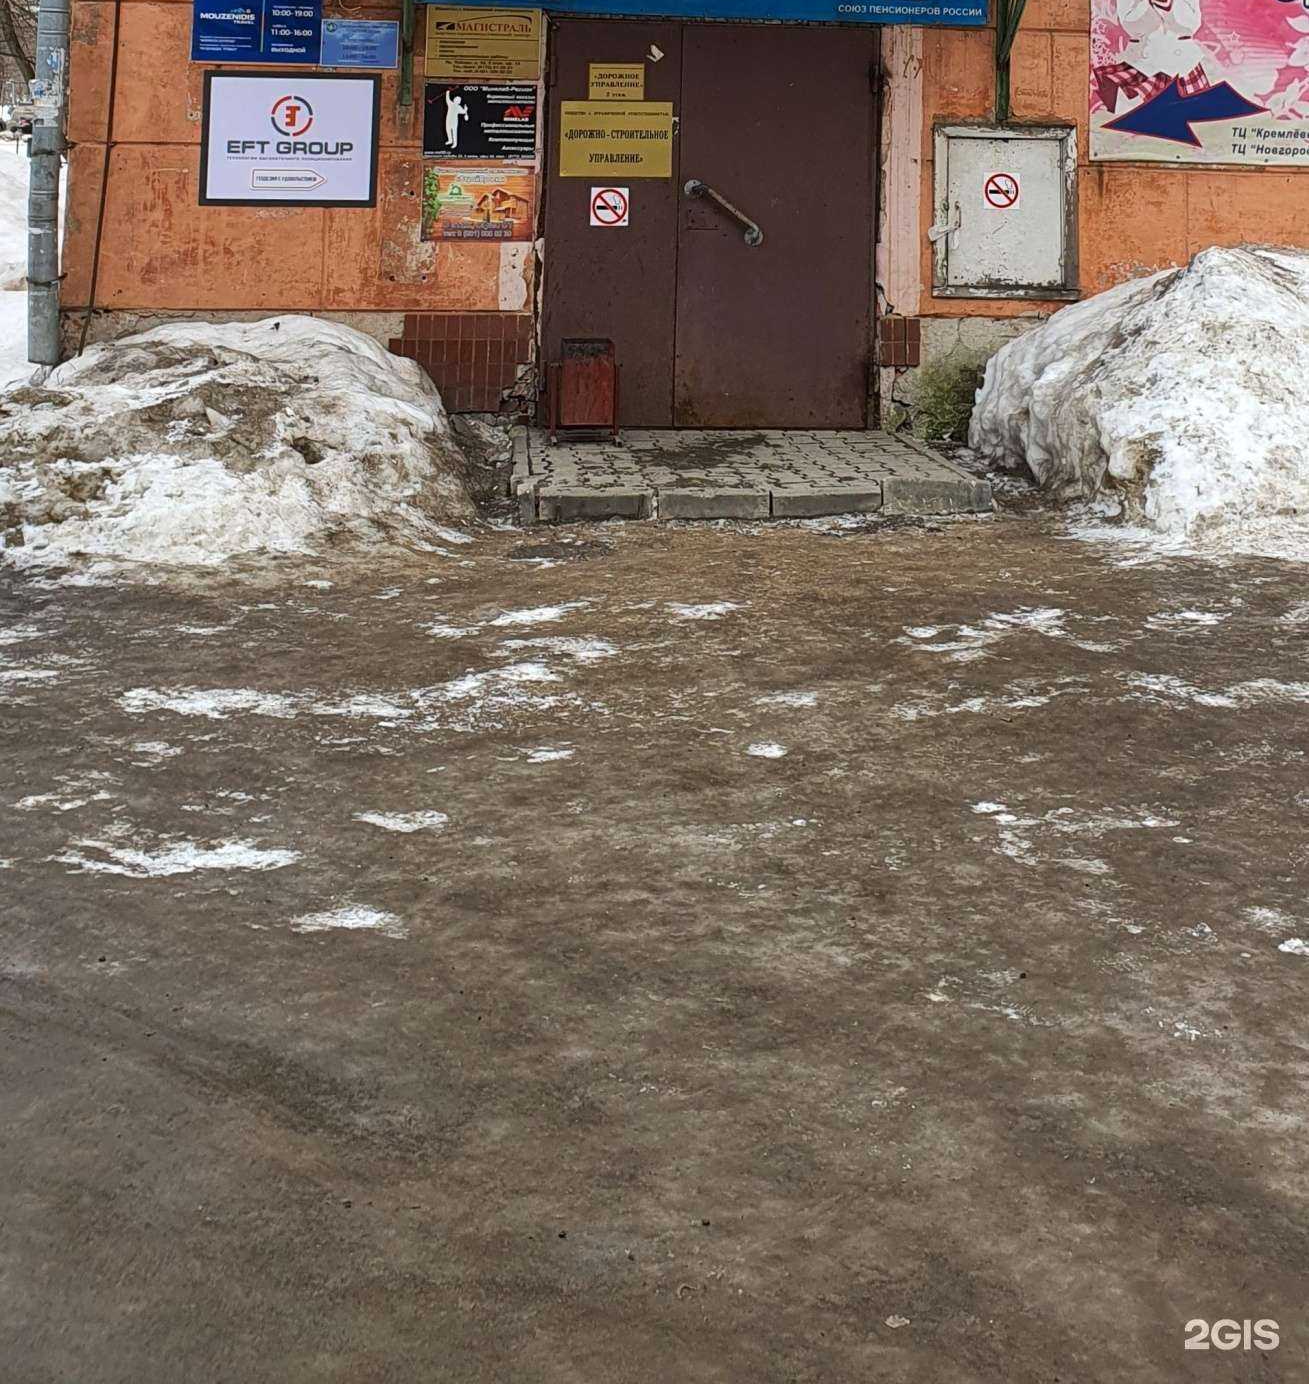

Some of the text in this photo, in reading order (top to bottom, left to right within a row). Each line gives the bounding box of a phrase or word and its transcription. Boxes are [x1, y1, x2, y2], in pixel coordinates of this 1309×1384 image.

[200, 12, 256, 21] MOUZENIDIS
[838, 4, 983, 17] СОЮЗ ПЕНСИОНЕРОВ РОССИИ
[455, 22, 532, 33] МАГИСТРАЛЬ
[1231, 127, 1309, 141] ТЦ "Кремлёв
[227, 140, 354, 156] EFT GROUP
[1231, 143, 1247, 157] ТЦ
[588, 153, 644, 164] УПРАВЛЕНИЕ»
